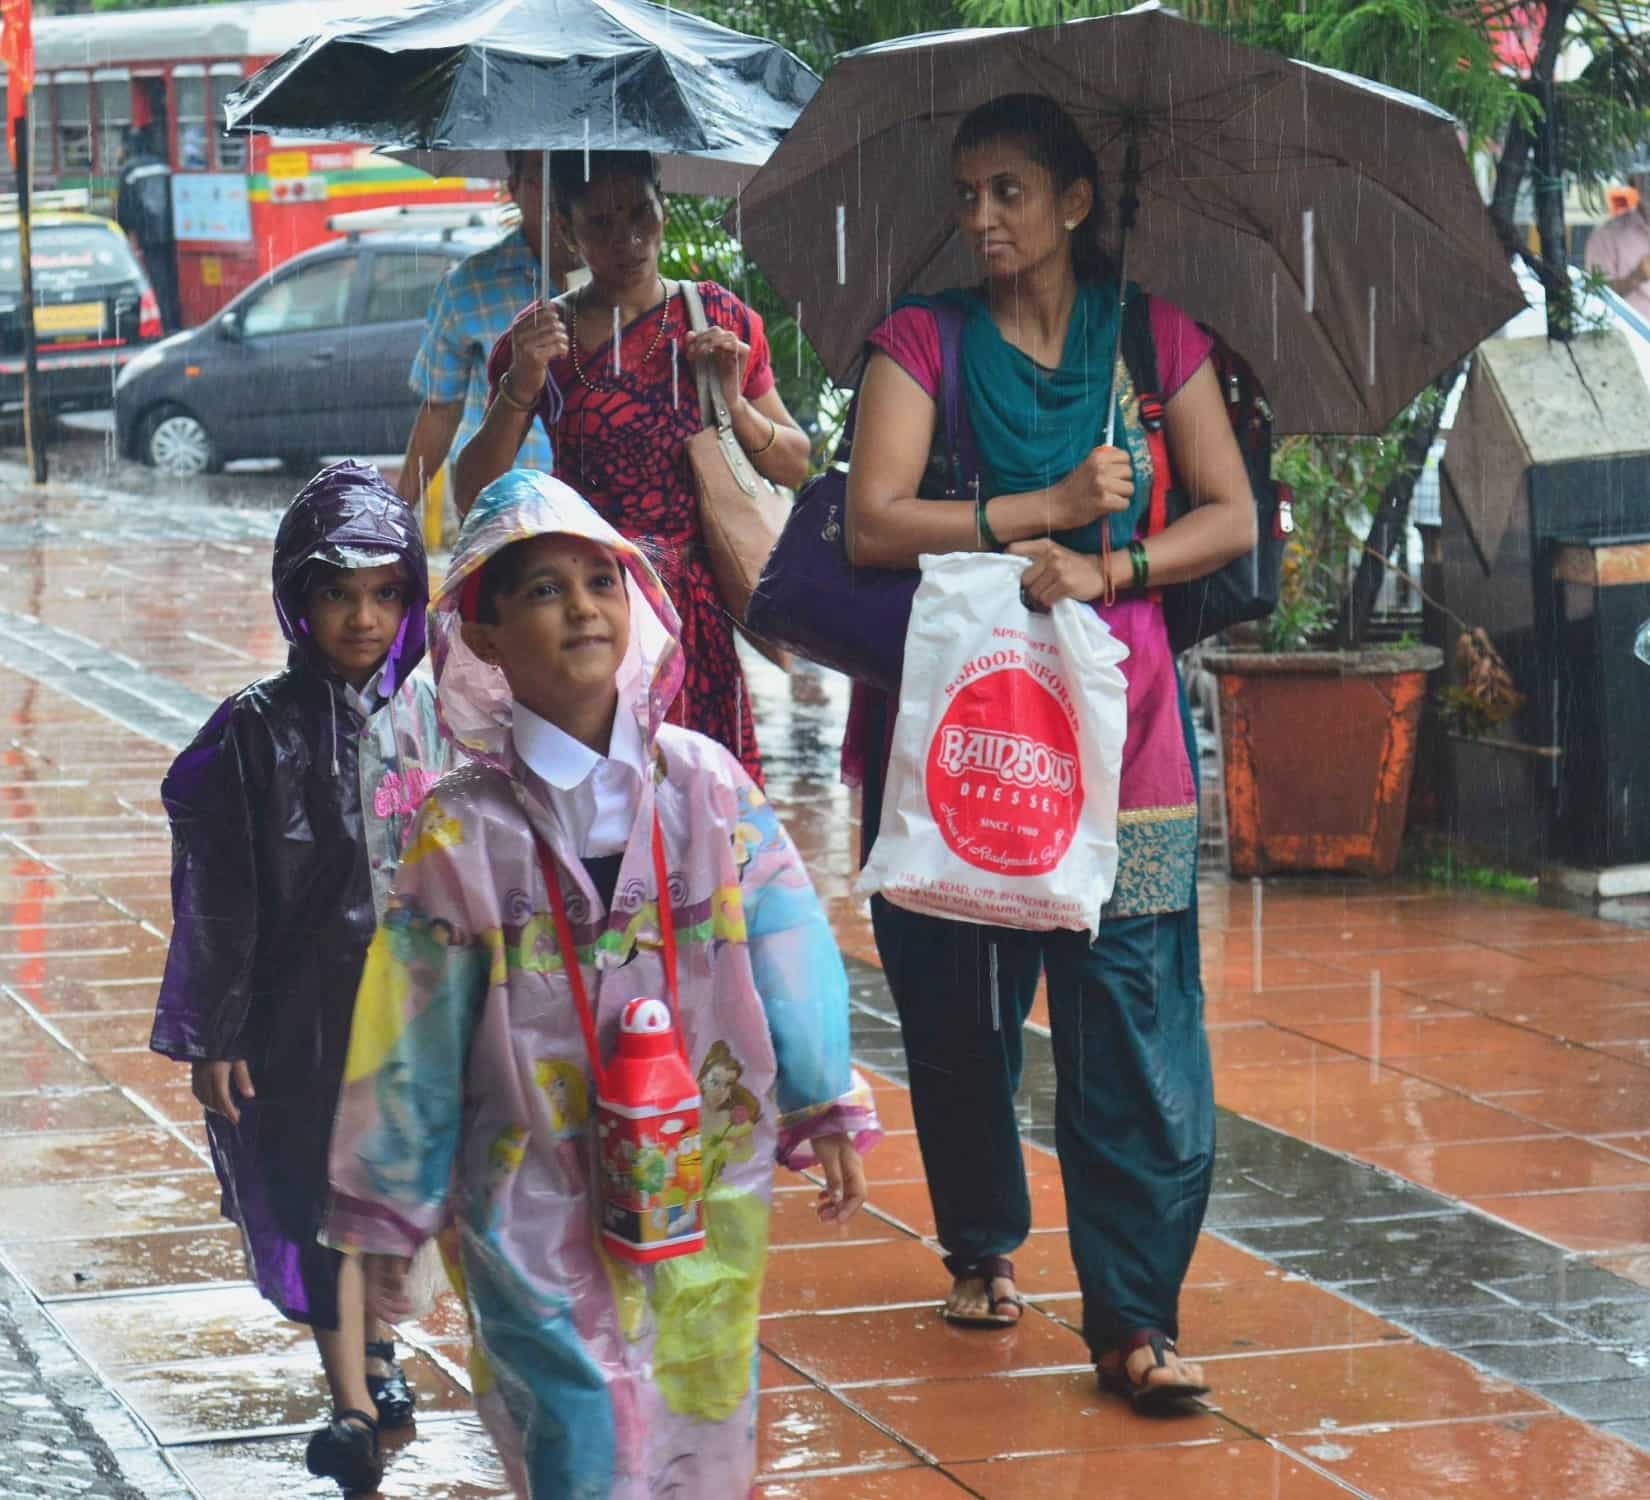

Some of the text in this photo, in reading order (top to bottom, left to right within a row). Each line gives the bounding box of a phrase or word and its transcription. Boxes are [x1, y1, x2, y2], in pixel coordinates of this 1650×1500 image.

[944, 649, 1022, 697] SCHOOL
[940, 727, 1075, 793] RAINBOW
[980, 817, 1008, 832] SINCE
[956, 835, 975, 849] of
